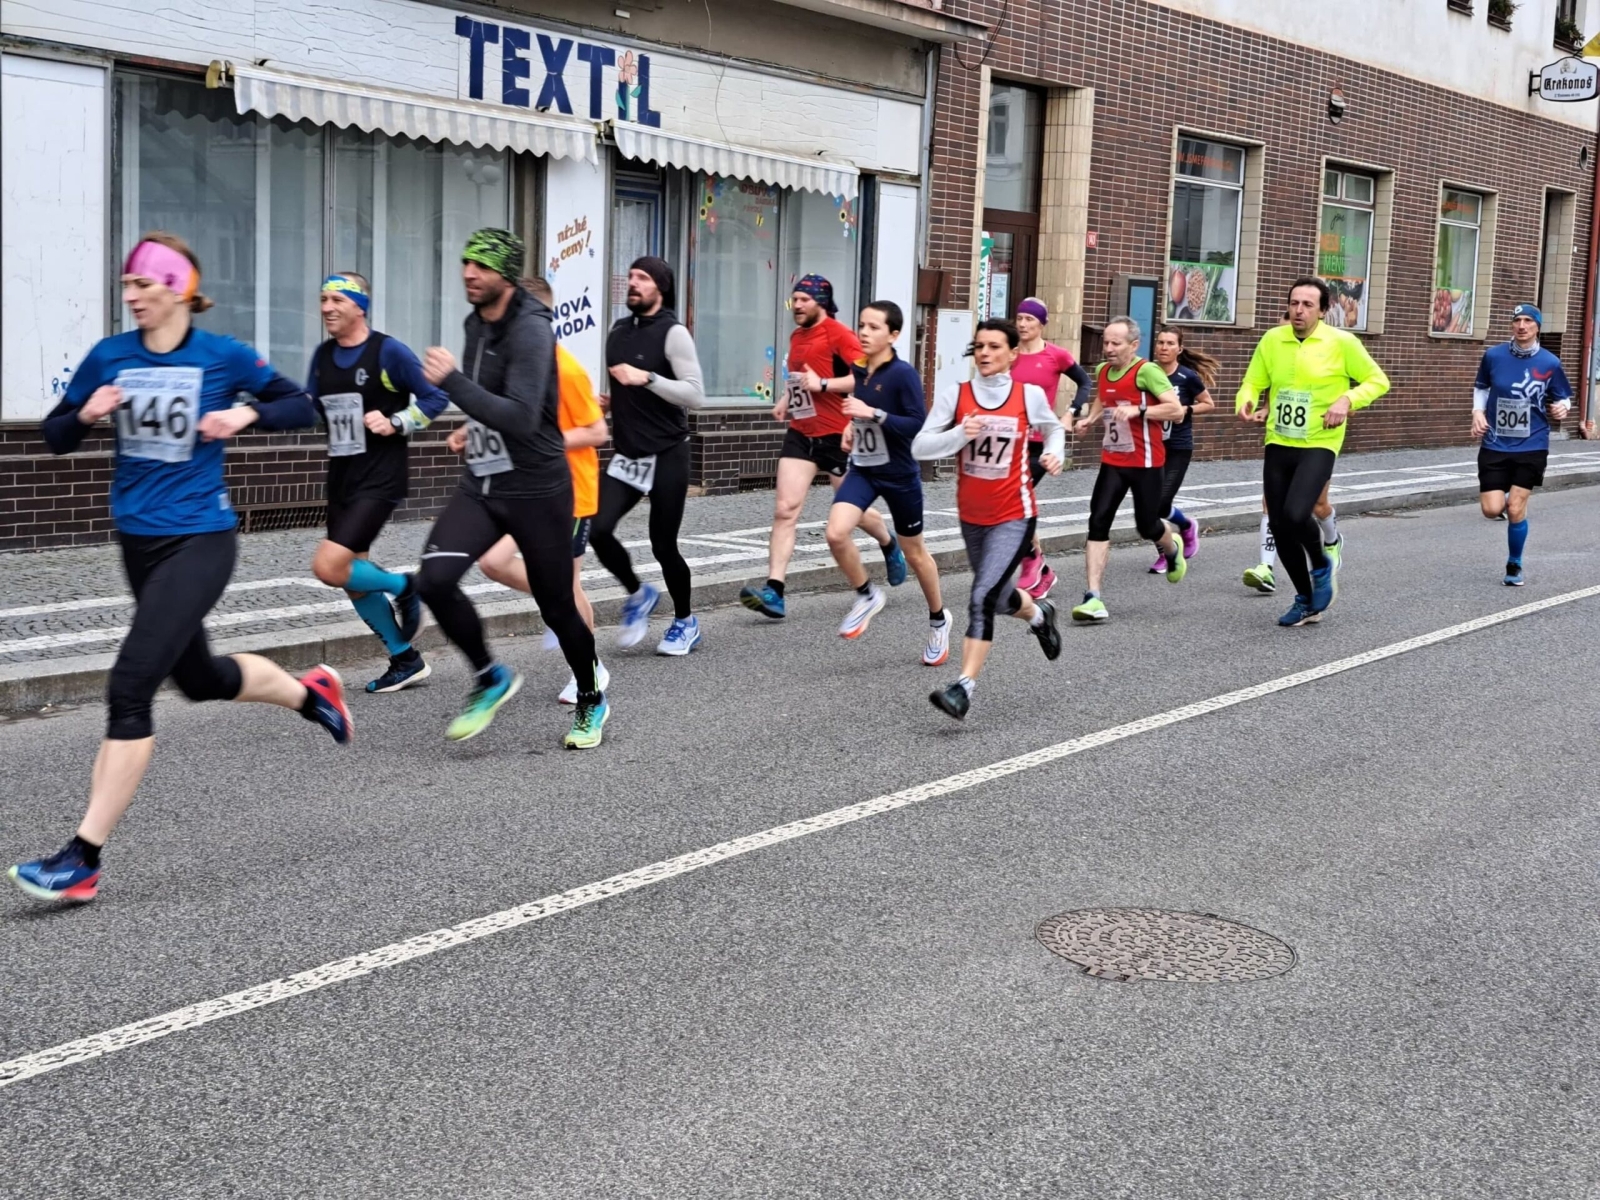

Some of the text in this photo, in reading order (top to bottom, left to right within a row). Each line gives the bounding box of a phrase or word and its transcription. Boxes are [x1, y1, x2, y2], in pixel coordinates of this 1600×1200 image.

[455, 15, 660, 128] TEXTIL
[557, 215, 587, 243] nízké
[561, 230, 591, 260] ceny!
[788, 385, 811, 409] 251
[119, 395, 189, 439] 146
[332, 414, 355, 441] 111
[1276, 402, 1306, 427] 188
[1498, 410, 1529, 428] 304
[968, 435, 1011, 464] 147
